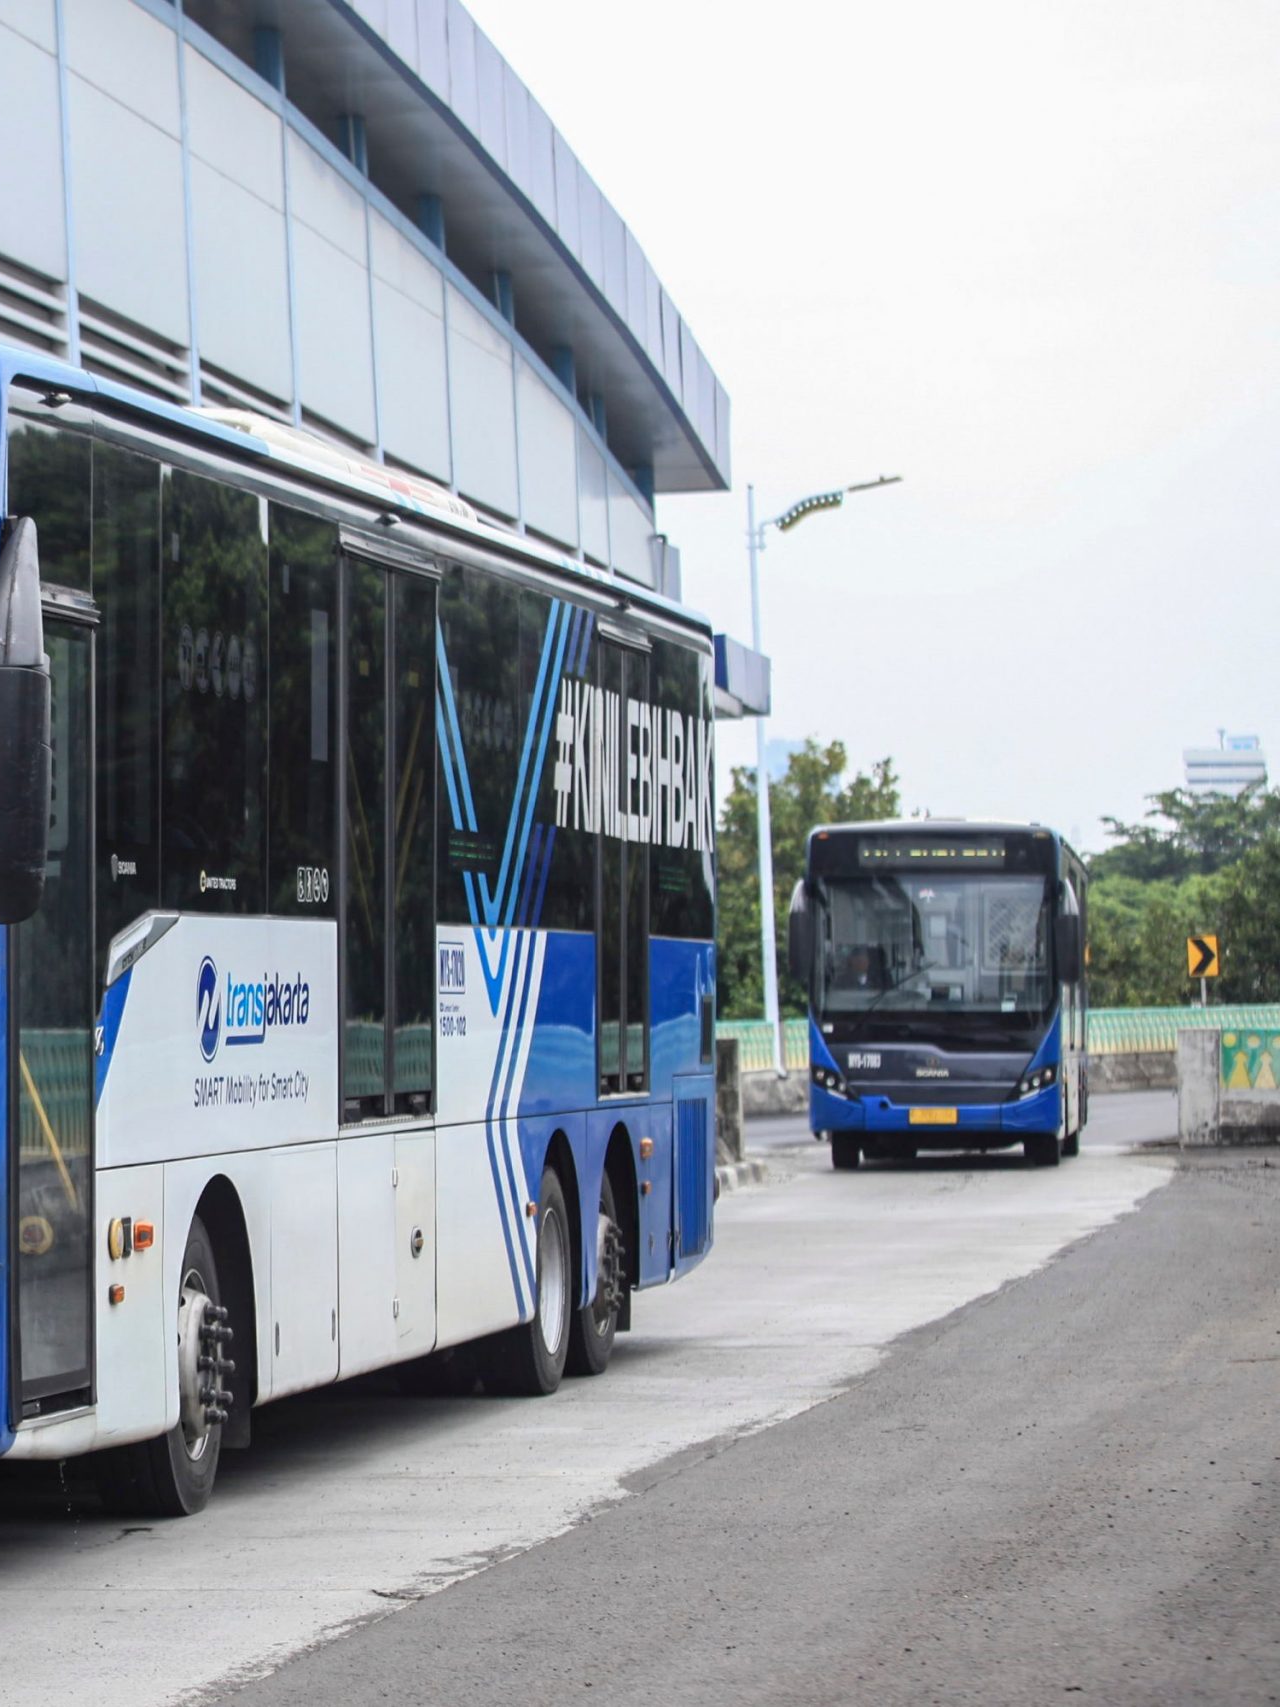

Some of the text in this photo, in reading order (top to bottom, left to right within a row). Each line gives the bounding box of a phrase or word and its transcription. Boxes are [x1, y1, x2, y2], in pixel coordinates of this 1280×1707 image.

[554, 677, 714, 853] #KINILEBIHBAIK
[225, 971, 310, 1046] transjakarta
[439, 1015, 466, 1037] 1500-102
[194, 1069, 310, 1109] SMART Mobility for Smart City
